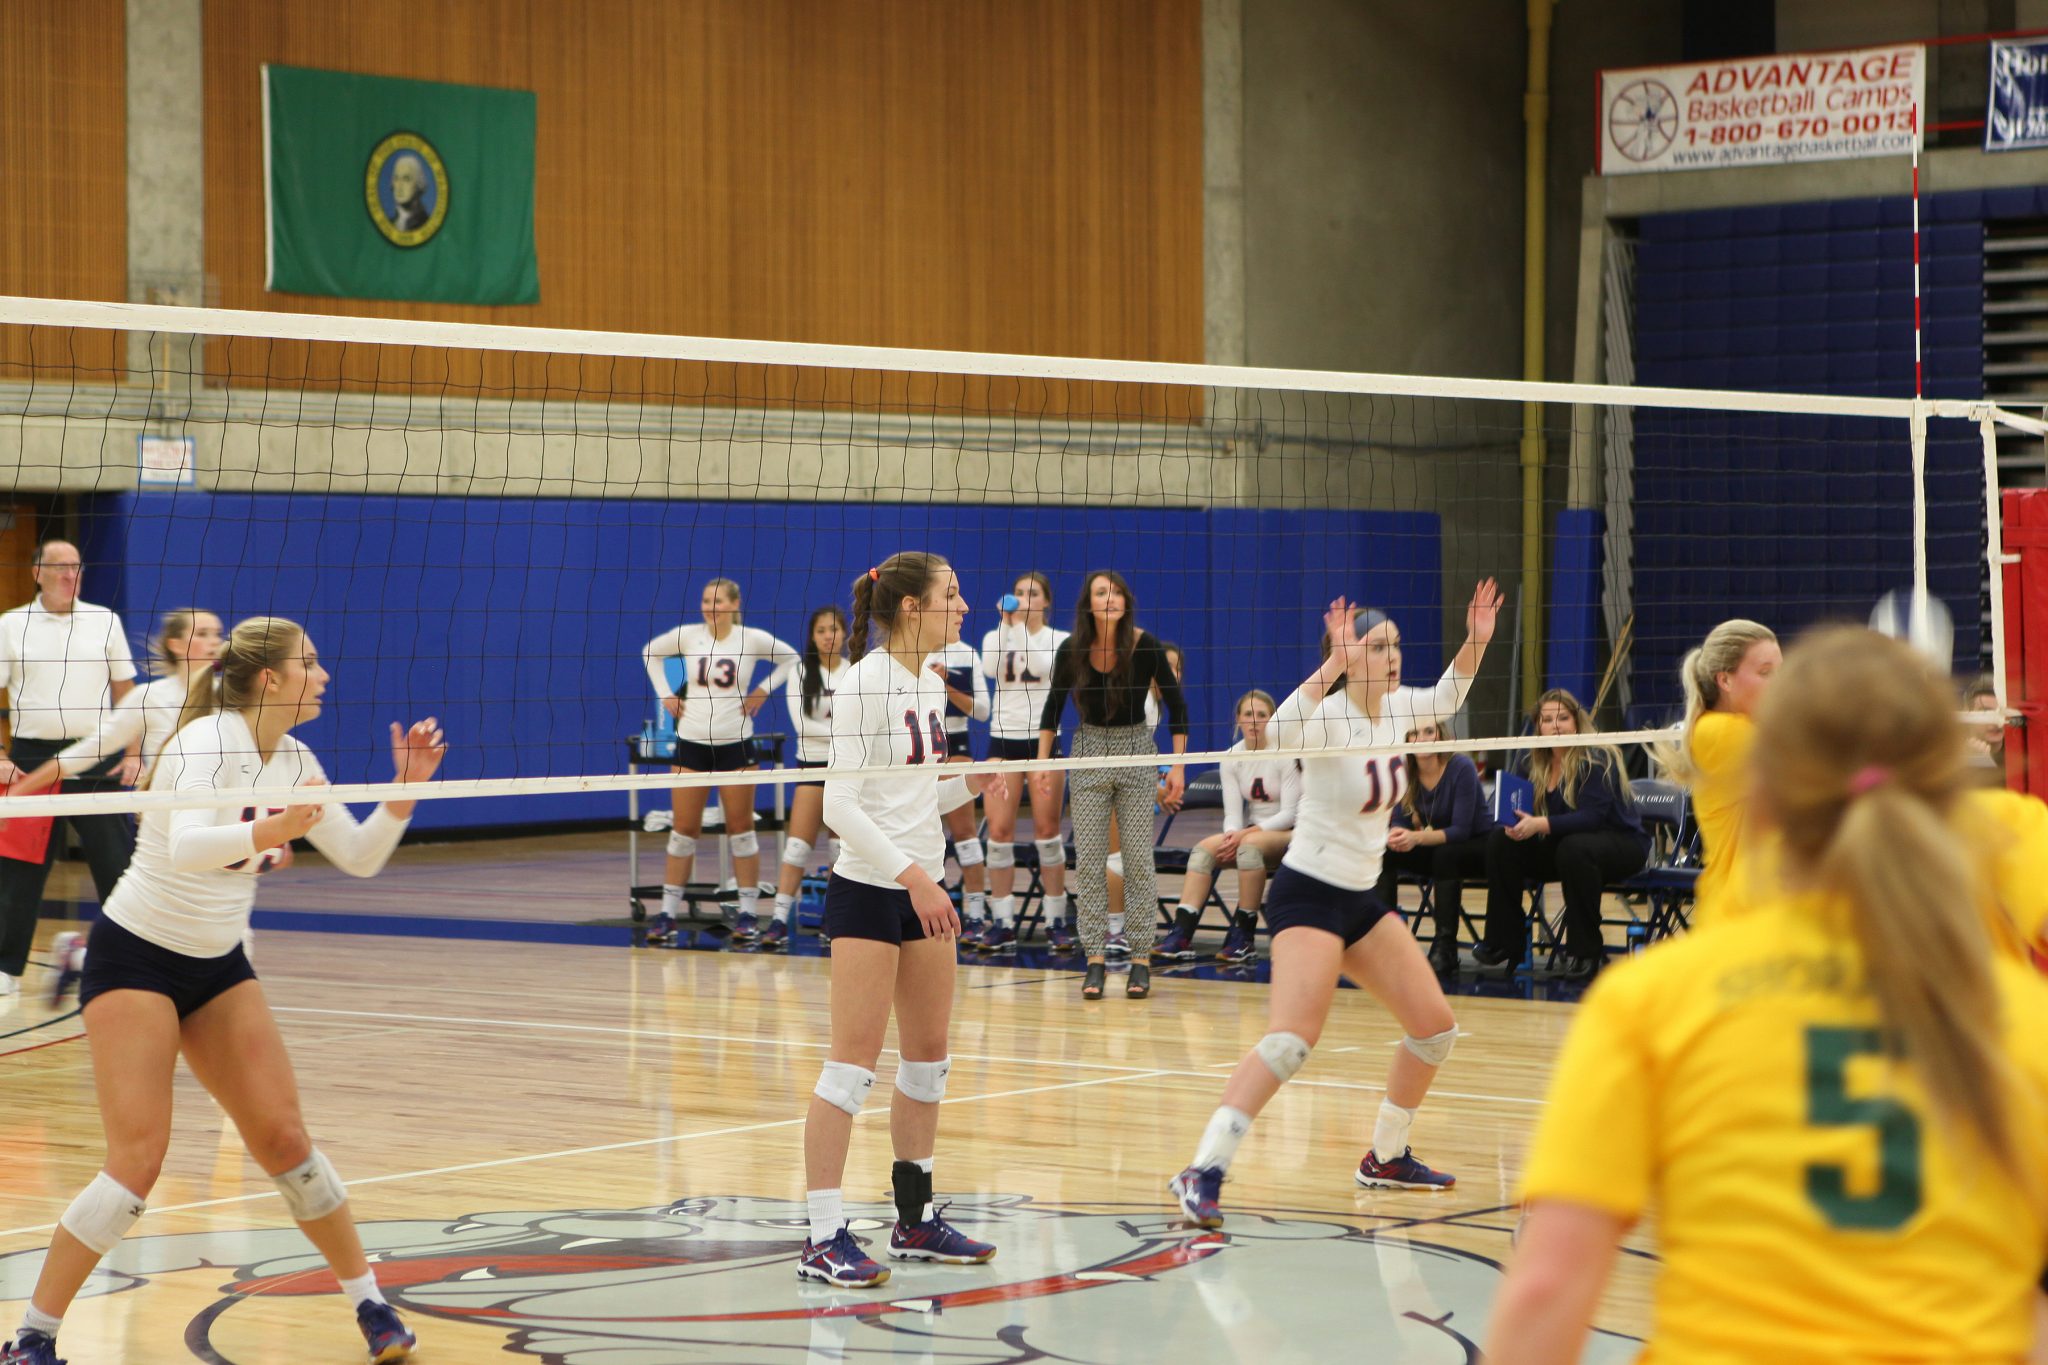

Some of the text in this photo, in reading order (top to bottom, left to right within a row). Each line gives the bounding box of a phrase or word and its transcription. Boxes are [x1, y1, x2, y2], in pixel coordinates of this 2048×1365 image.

[1686, 50, 1916, 96] ADVANTAGE
[1687, 83, 1912, 123] Basketball Camps
[1684, 111, 1914, 146] 1-800-670-0013
[697, 657, 737, 689] 13
[1250, 778, 1272, 802] 4
[1803, 1025, 1922, 1230] 5
